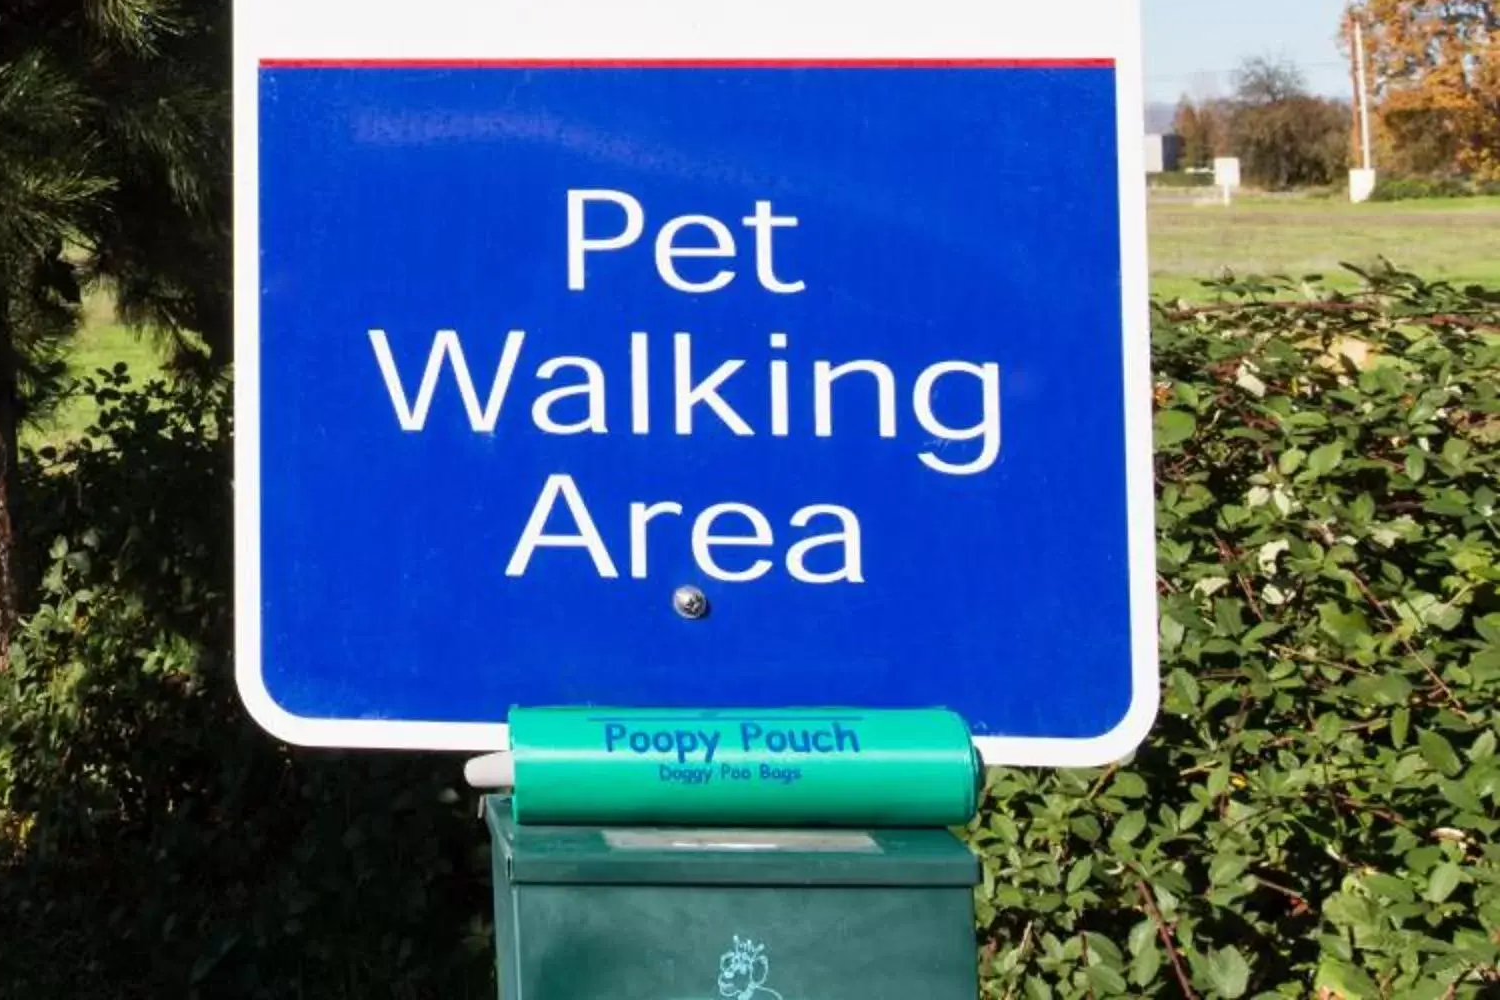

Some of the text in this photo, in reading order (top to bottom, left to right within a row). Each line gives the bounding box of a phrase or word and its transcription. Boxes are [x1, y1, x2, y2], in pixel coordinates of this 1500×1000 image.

[567, 189, 805, 294] Pet
[368, 329, 1002, 476] Walking
[505, 474, 866, 584] Area
[604, 720, 860, 763] Poopy Pouch
[659, 763, 803, 784] Doggy Poo Bags
